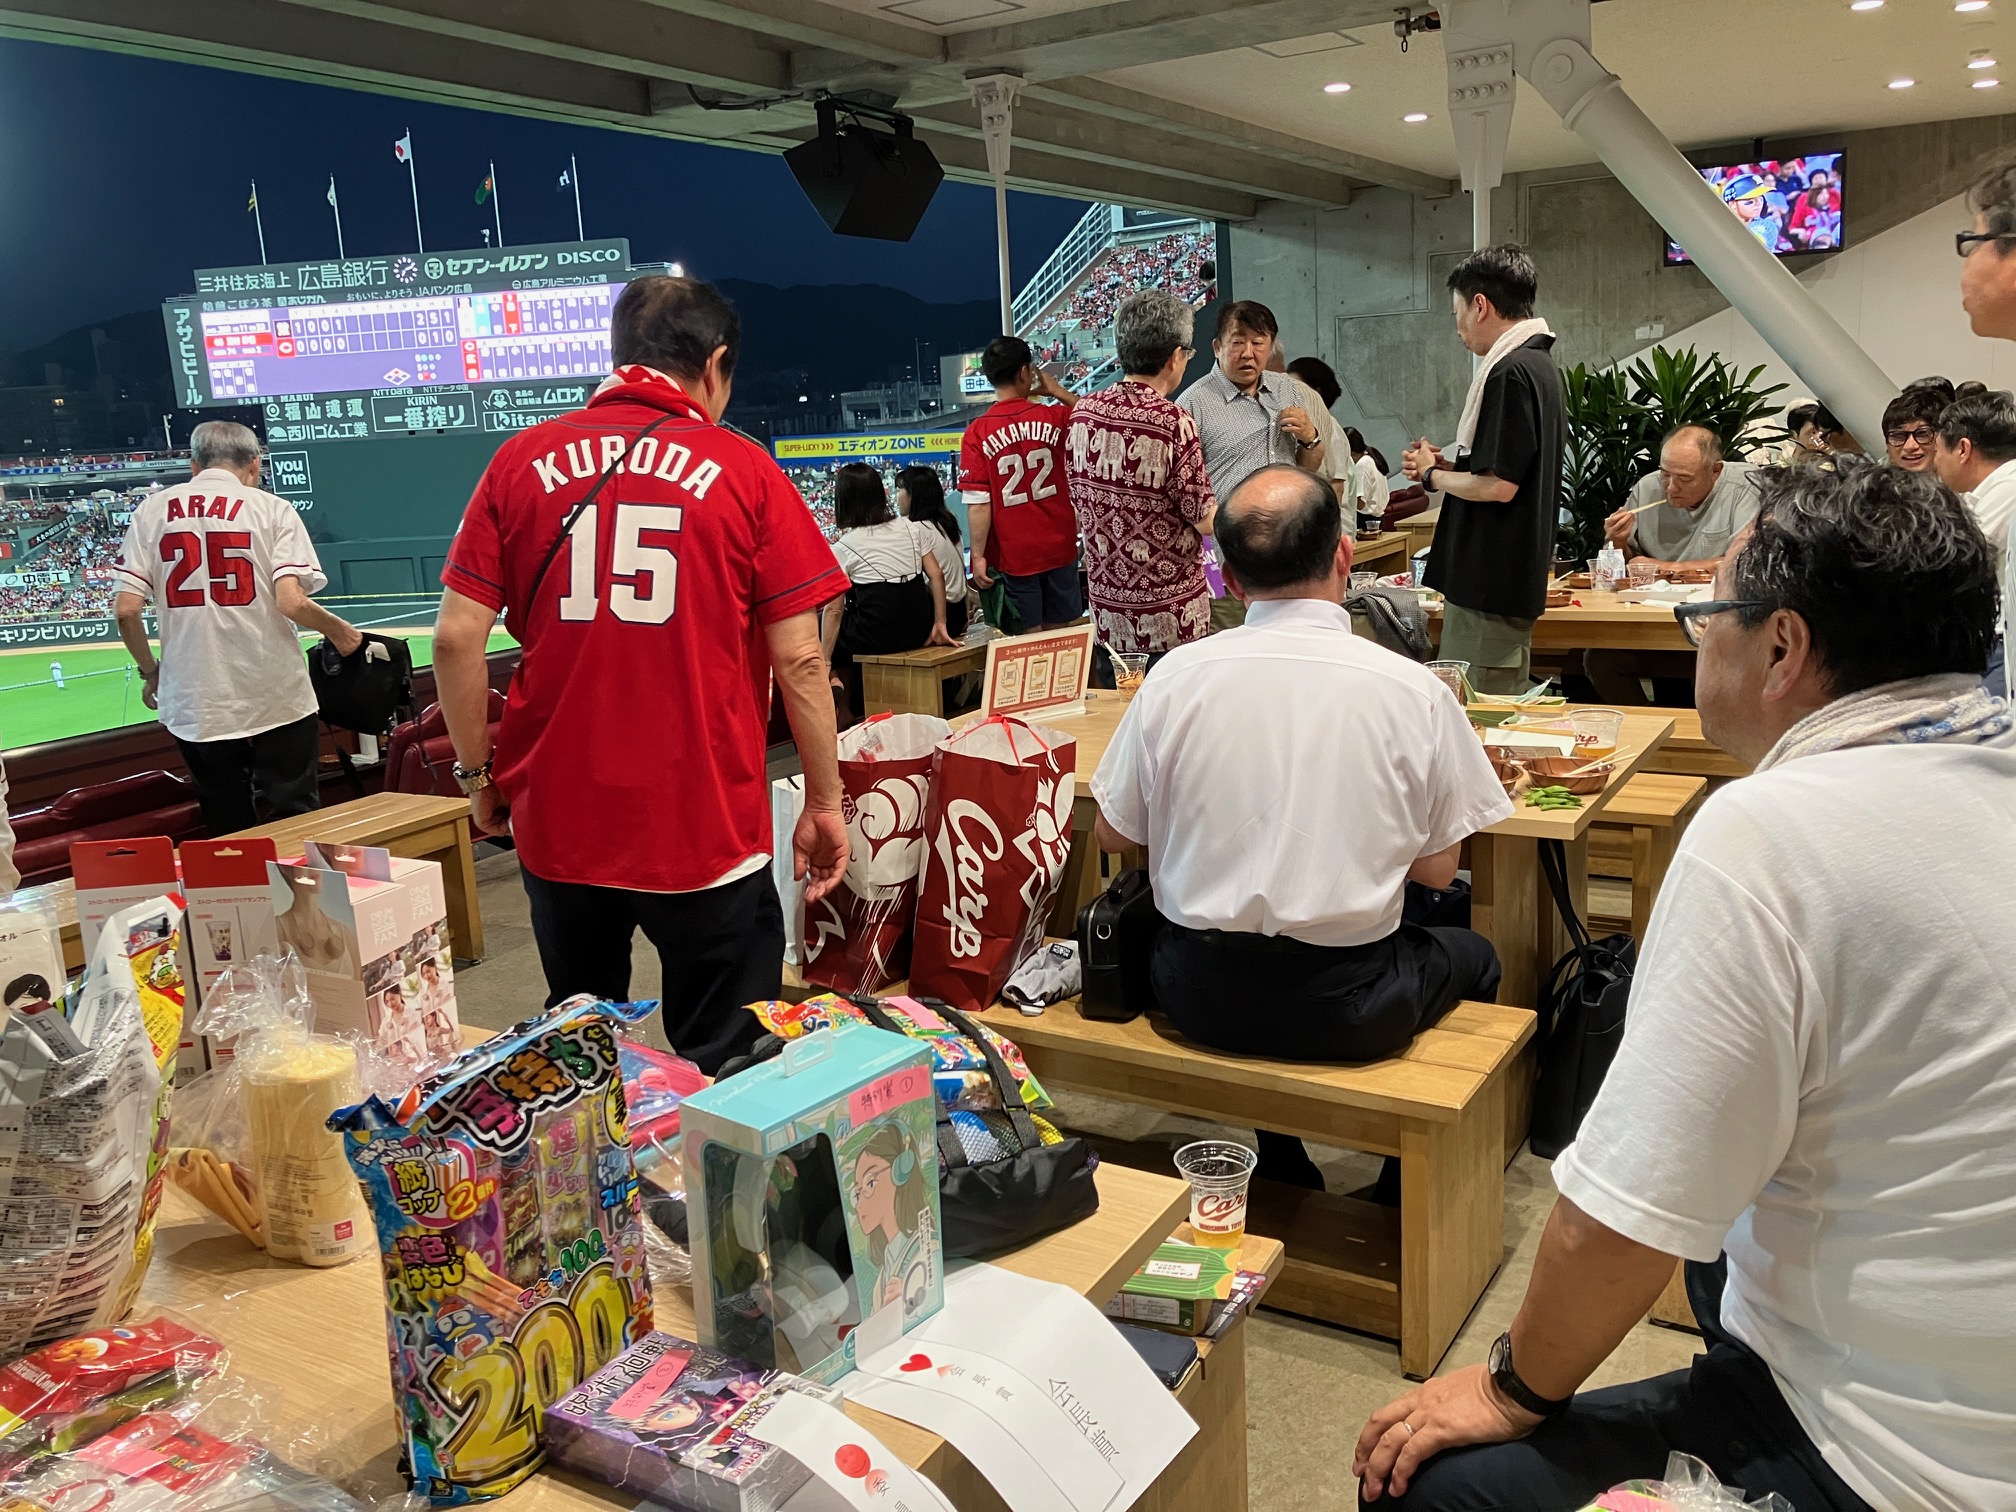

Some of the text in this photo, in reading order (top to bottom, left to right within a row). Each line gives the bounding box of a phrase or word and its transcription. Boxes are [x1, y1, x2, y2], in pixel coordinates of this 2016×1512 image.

[557, 249, 620, 265] DISCO
[198, 260, 389, 292] 三井住友海上 広島銀行
[416, 283, 472, 297] JAバンク広島
[173, 308, 203, 406] アサヒビール
[280, 393, 314, 402] MARUI
[406, 396, 438, 406] KIRIN
[543, 386, 585, 404] ムロオ
[284, 398, 365, 422] 福山通運
[384, 404, 466, 428] 一番搾り
[286, 422, 368, 442] 西川ゴム工業
[838, 436, 926, 452] エディオン ZONE
[982, 421, 1062, 460] NAKAMURA
[274, 459, 303, 476] you
[282, 472, 306, 486] me
[532, 434, 722, 500] KURODA
[997, 447, 1058, 508] 22
[167, 494, 244, 523] ARAI
[159, 531, 256, 608] 25
[560, 501, 686, 626] 15
[0, 622, 109, 644] キリンビバレッジ
[935, 798, 1004, 958] Carp
[393, 1160, 428, 1194] 紙
[397, 1188, 442, 1216] コップ
[1198, 1193, 1247, 1222] Car
[428, 1260, 634, 1483] 200
[1047, 1376, 1122, 1464] 会長賞
